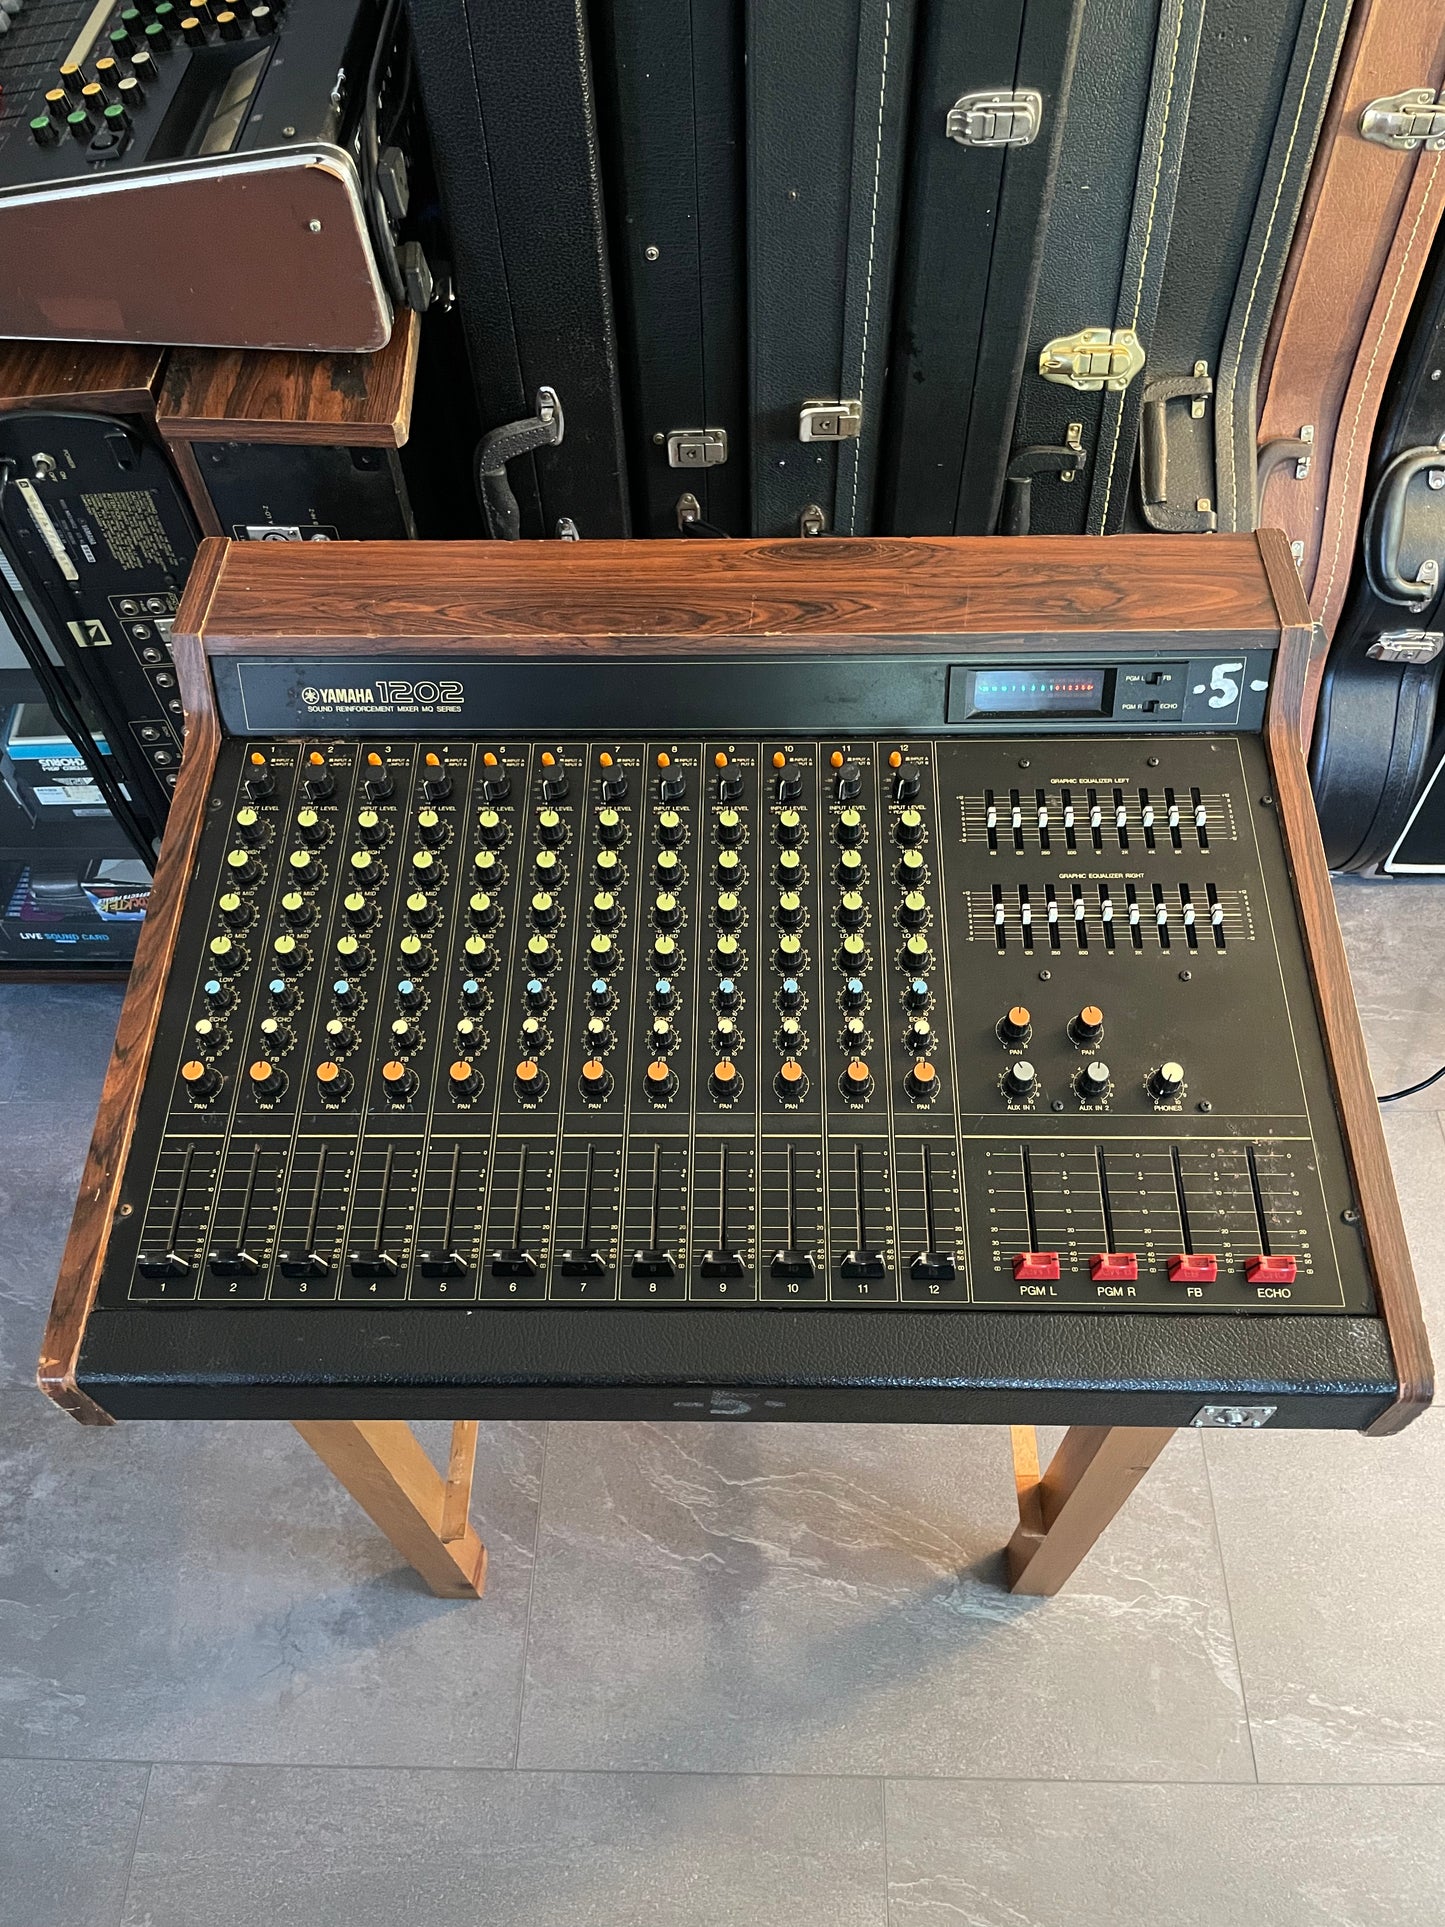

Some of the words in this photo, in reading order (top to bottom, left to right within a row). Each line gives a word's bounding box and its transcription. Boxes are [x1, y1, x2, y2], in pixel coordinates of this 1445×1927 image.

[1207, 662, 1243, 709] 5
[320, 688, 374, 703] YAMAHA
[375, 681, 465, 704] 1202
[784, 745, 794, 753] 10
[899, 744, 909, 752] 12
[39, 758, 85, 767] CHORUS
[20, 932, 43, 940] LIVE
[160, 1283, 166, 1292] 1
[229, 1283, 238, 1292] 2
[299, 1283, 308, 1292] 3
[369, 1283, 377, 1292] 4
[439, 1283, 447, 1292] 5
[509, 1283, 517, 1292] 6
[580, 1283, 587, 1292] 7
[649, 1283, 657, 1292] 8
[719, 1283, 727, 1293] 9
[787, 1284, 799, 1293] 10
[858, 1284, 869, 1293] 11
[928, 1285, 940, 1295] 12
[1020, 1286, 1048, 1296] PGM
[1050, 1286, 1058, 1297] L
[1097, 1287, 1125, 1297] PGM
[1127, 1287, 1136, 1297] R
[1187, 1288, 1203, 1298] FB
[1257, 1288, 1291, 1299] ECHO
